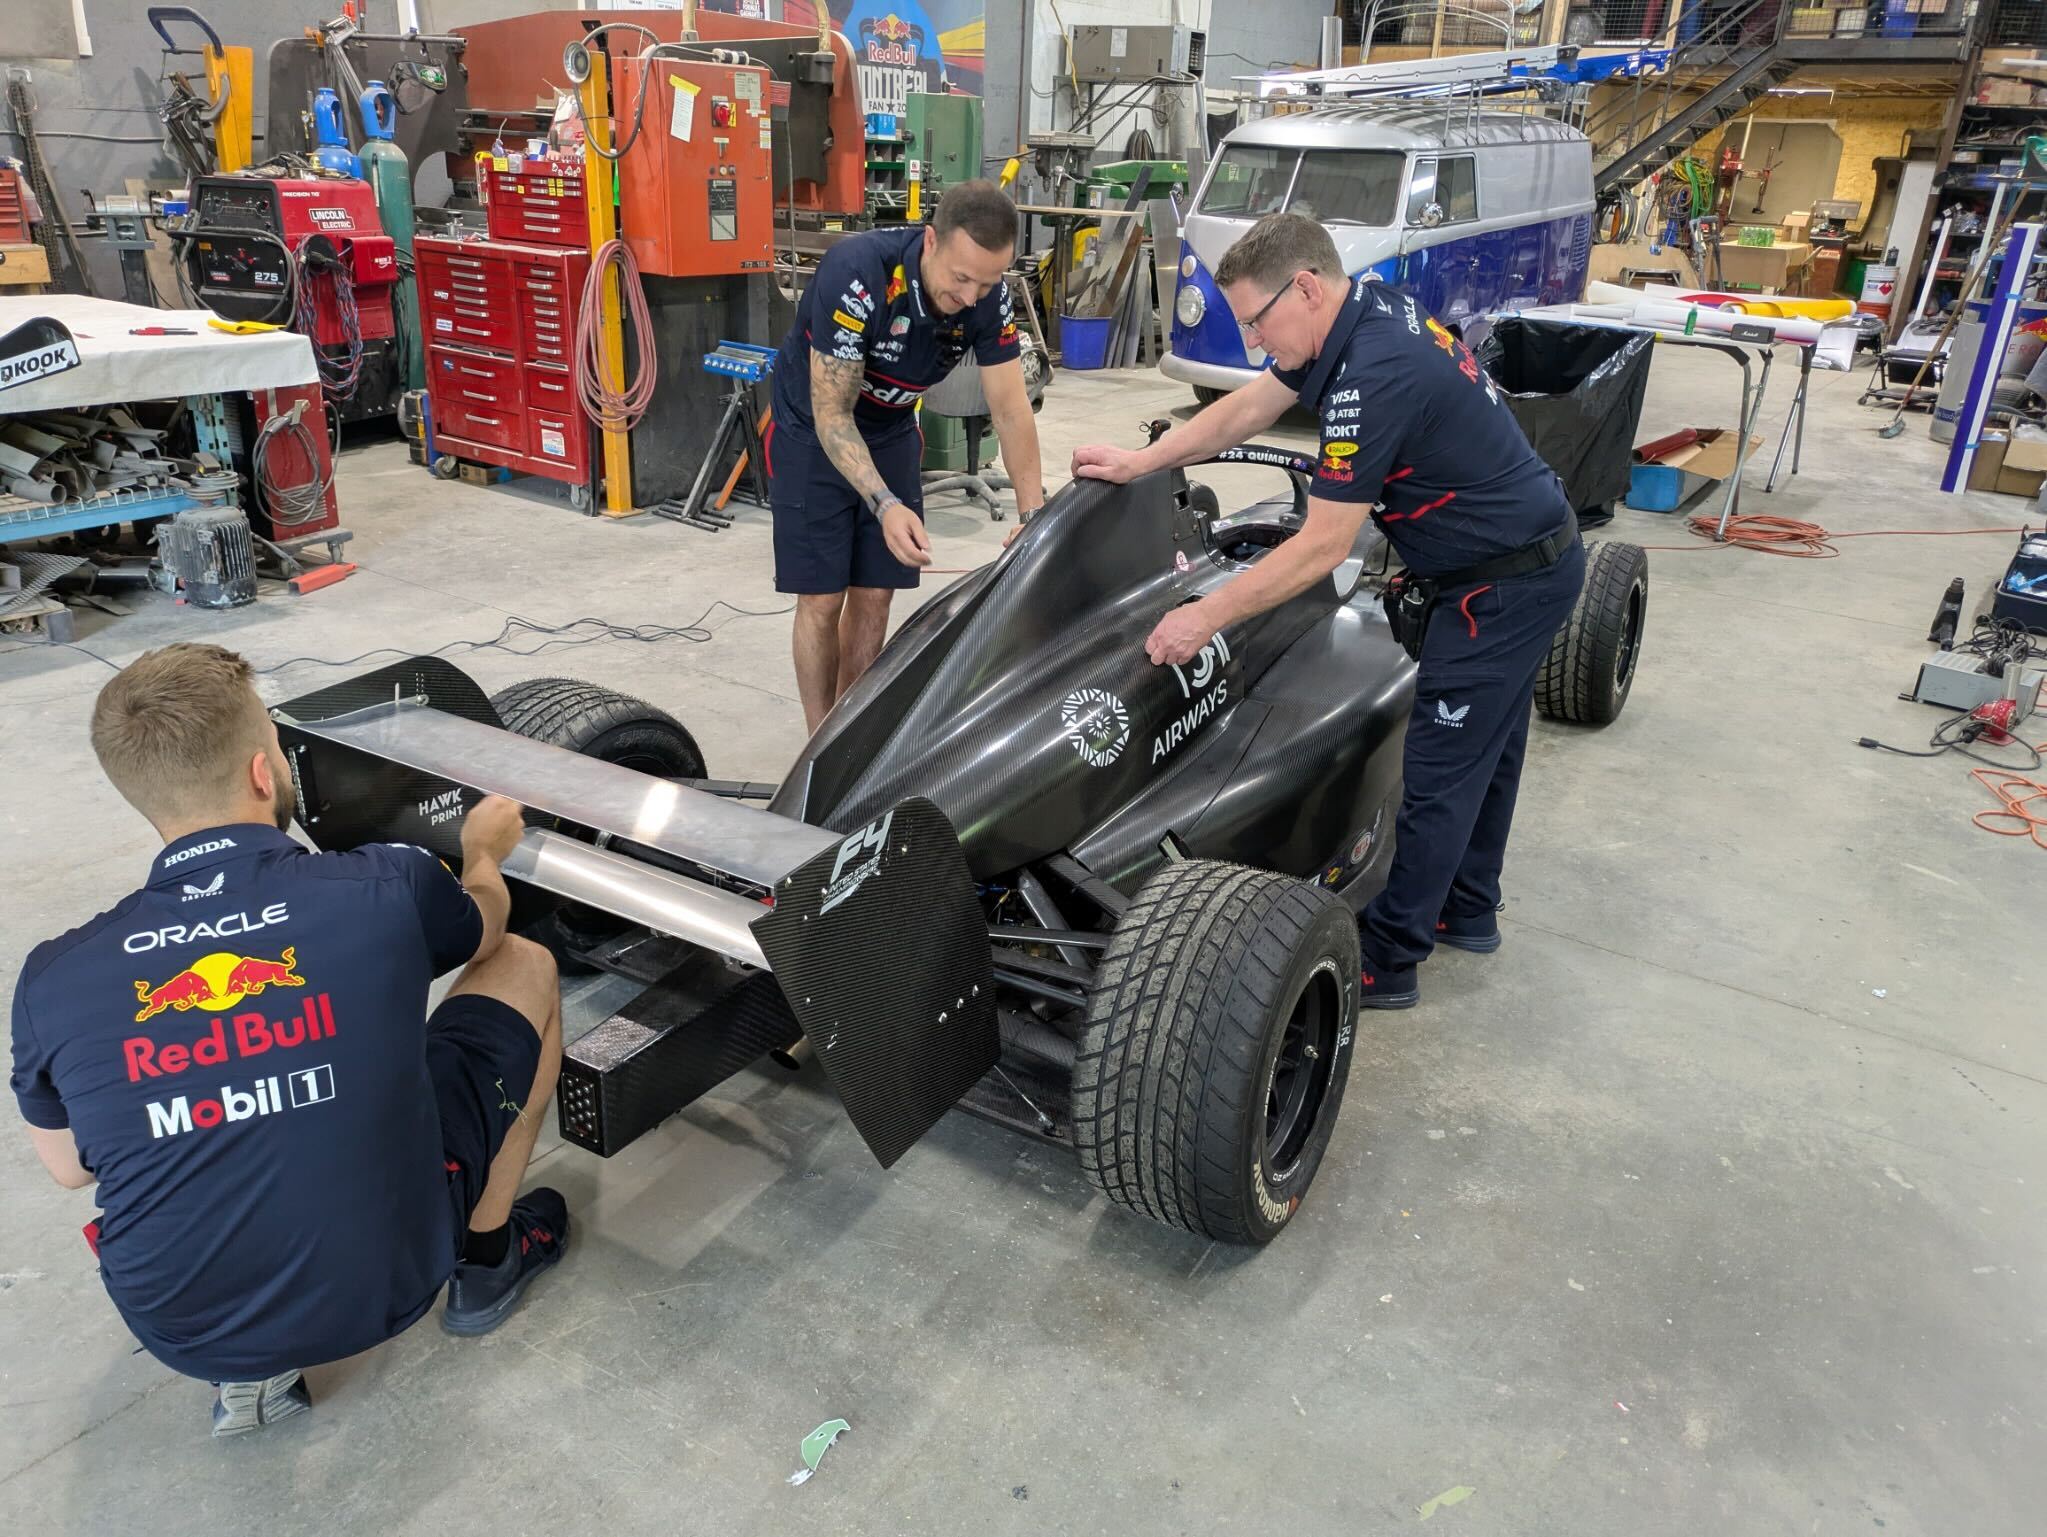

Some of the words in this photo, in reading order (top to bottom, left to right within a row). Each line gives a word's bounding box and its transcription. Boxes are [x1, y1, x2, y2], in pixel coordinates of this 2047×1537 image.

[867, 40, 893, 63] Red
[893, 42, 916, 66] Bull
[868, 101, 884, 111] FAN
[311, 209, 346, 220] LINCOLN
[322, 221, 352, 229] ELECTRIC
[255, 271, 279, 281] 275
[1331, 389, 1360, 405] VISA
[1337, 408, 1361, 419] AT&T
[1325, 425, 1360, 438] ROKT
[1218, 451, 1244, 460] #24
[1247, 450, 1292, 466] QUIMBY
[1318, 467, 1335, 480] Red
[1334, 470, 1354, 482] Bull
[1151, 678, 1228, 766] AIRWAYS
[418, 788, 463, 817] HAWK
[431, 805, 464, 827] PRINT
[164, 838, 238, 869] HONDA
[830, 810, 895, 885] F4
[854, 853, 881, 876] STATES
[123, 902, 290, 954] ORACLE
[123, 1017, 230, 1083] Red
[232, 993, 337, 1058] Bull
[146, 1076, 283, 1139] Mobil
[1272, 1173, 1284, 1182] OZ
